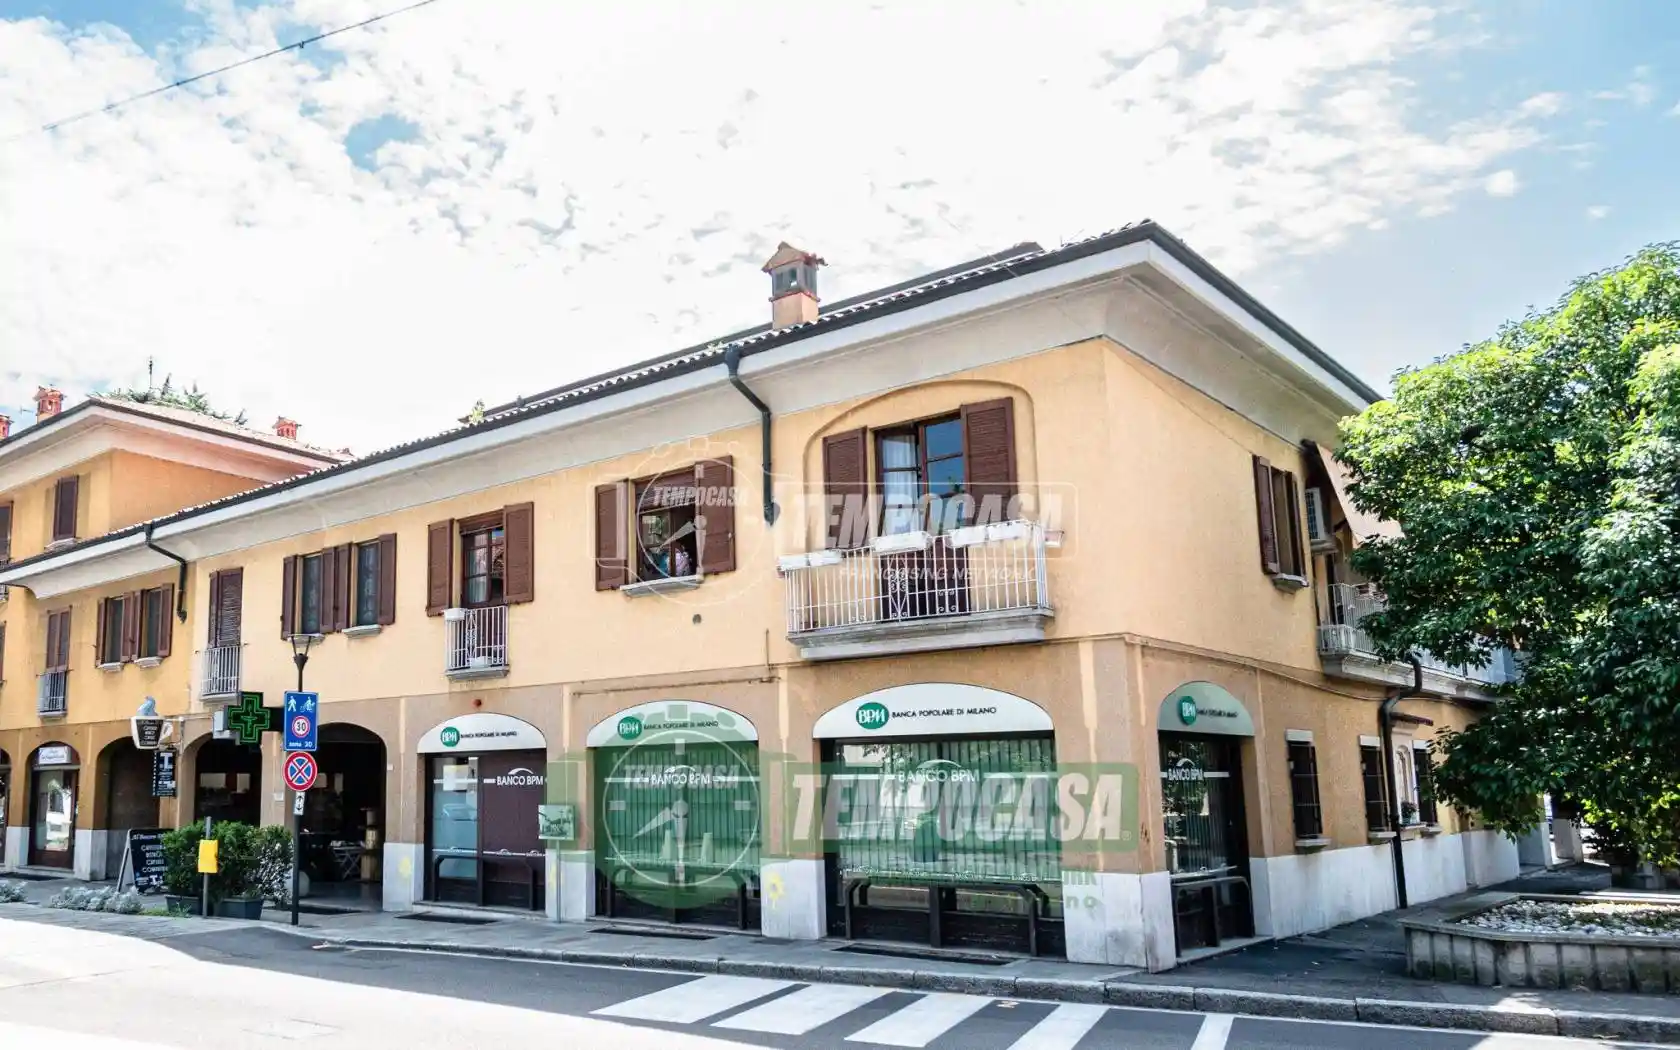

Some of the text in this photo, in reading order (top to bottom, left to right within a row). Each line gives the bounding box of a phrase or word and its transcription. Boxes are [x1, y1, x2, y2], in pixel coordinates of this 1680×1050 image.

[919, 709, 954, 717] POPOLARE
[296, 722, 306, 731] 30
[651, 774, 687, 784] BANCO
[898, 769, 980, 782] BANCO BPM
[1168, 768, 1190, 780] BANCO
[496, 776, 543, 786] BANCO BPM
